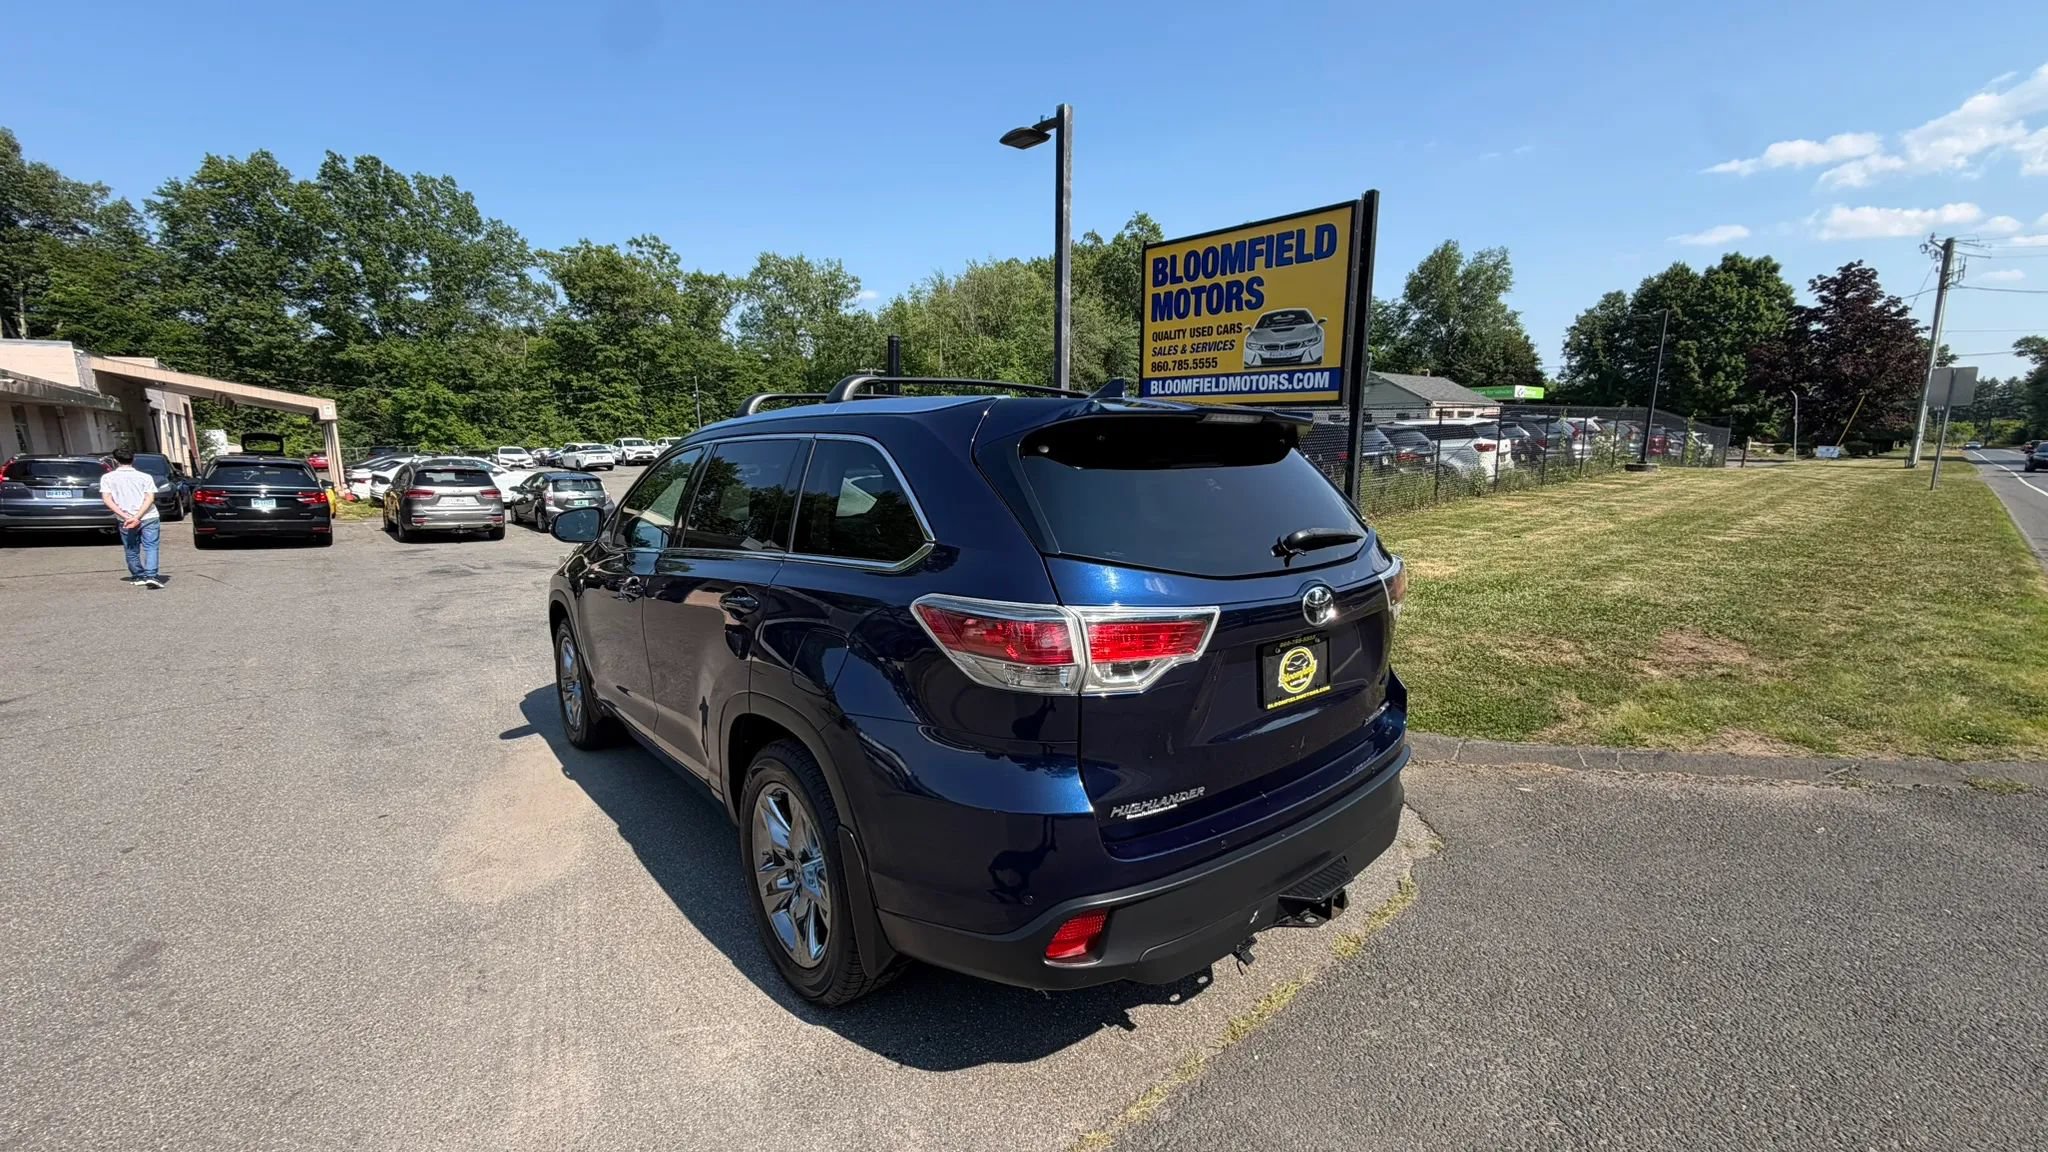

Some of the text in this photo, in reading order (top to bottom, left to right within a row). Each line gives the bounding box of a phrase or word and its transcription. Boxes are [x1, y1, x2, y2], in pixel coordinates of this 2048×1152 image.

[1152, 223, 1337, 288] BLOOMFIELD
[1151, 276, 1265, 322] MOTORS
[1152, 323, 1243, 343] QUALITY USED CARS
[1151, 339, 1236, 357] SALES & SERVICES
[1151, 357, 1218, 372] 860.785.5555
[1150, 371, 1330, 395] BLOOMFIELDMOTORS.COM
[1110, 786, 1205, 818] HIGHLANDER
